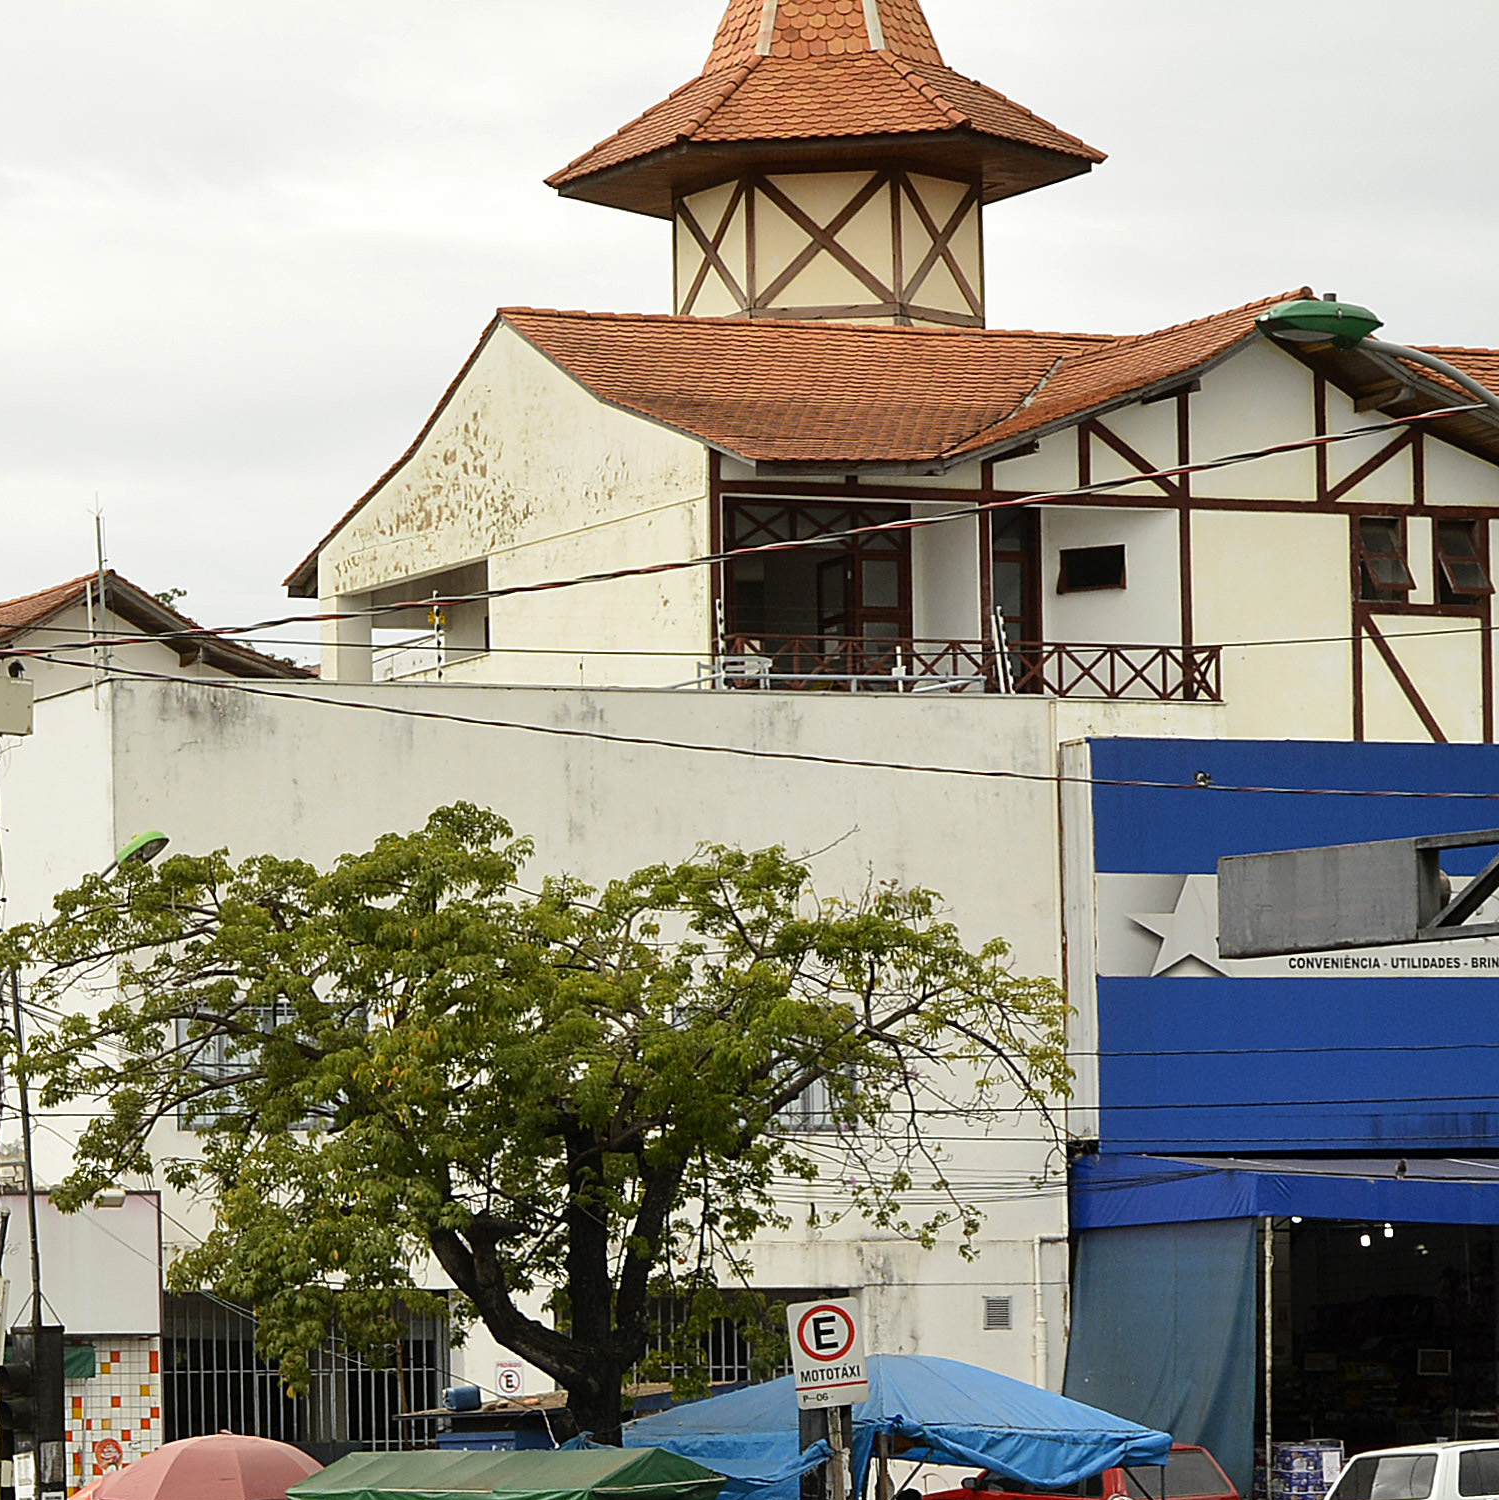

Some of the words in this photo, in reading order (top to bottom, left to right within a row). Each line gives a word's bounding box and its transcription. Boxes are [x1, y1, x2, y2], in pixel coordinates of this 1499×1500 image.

[1289, 955, 1381, 969] CONVENIÊNCIA
[1391, 957, 1461, 969] UTILIDADES
[812, 1315, 839, 1350] E
[800, 1363, 861, 1383] MOTOTÁXI
